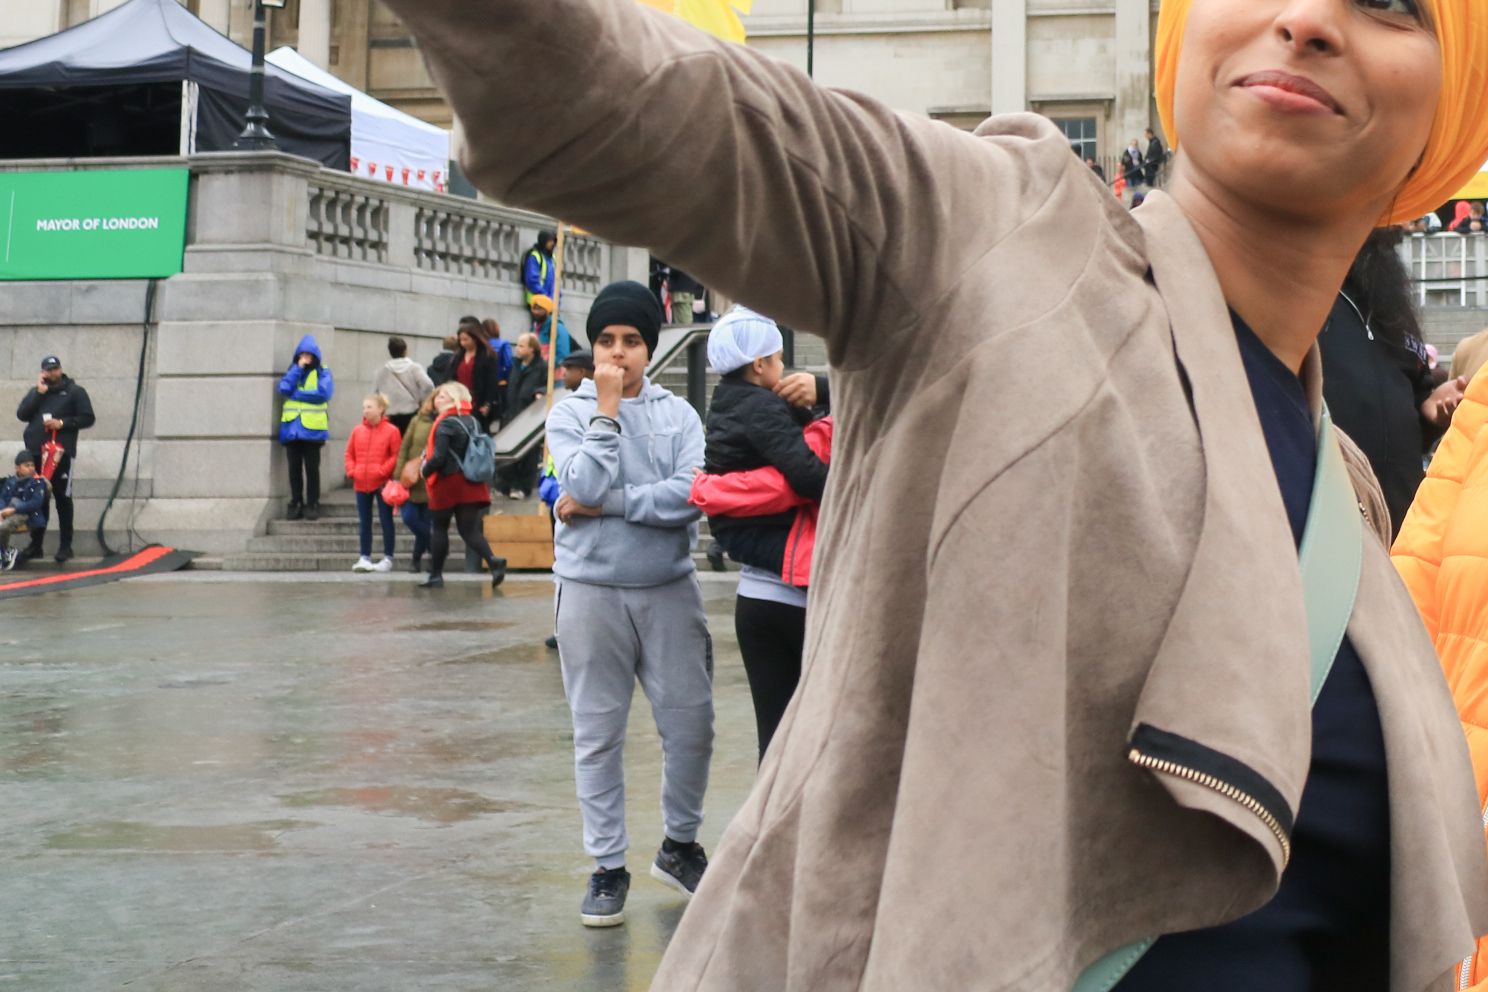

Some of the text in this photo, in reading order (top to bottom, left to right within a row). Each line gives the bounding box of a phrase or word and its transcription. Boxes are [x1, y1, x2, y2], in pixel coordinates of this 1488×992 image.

[36, 217, 158, 231] MAYOR OF LONDON
